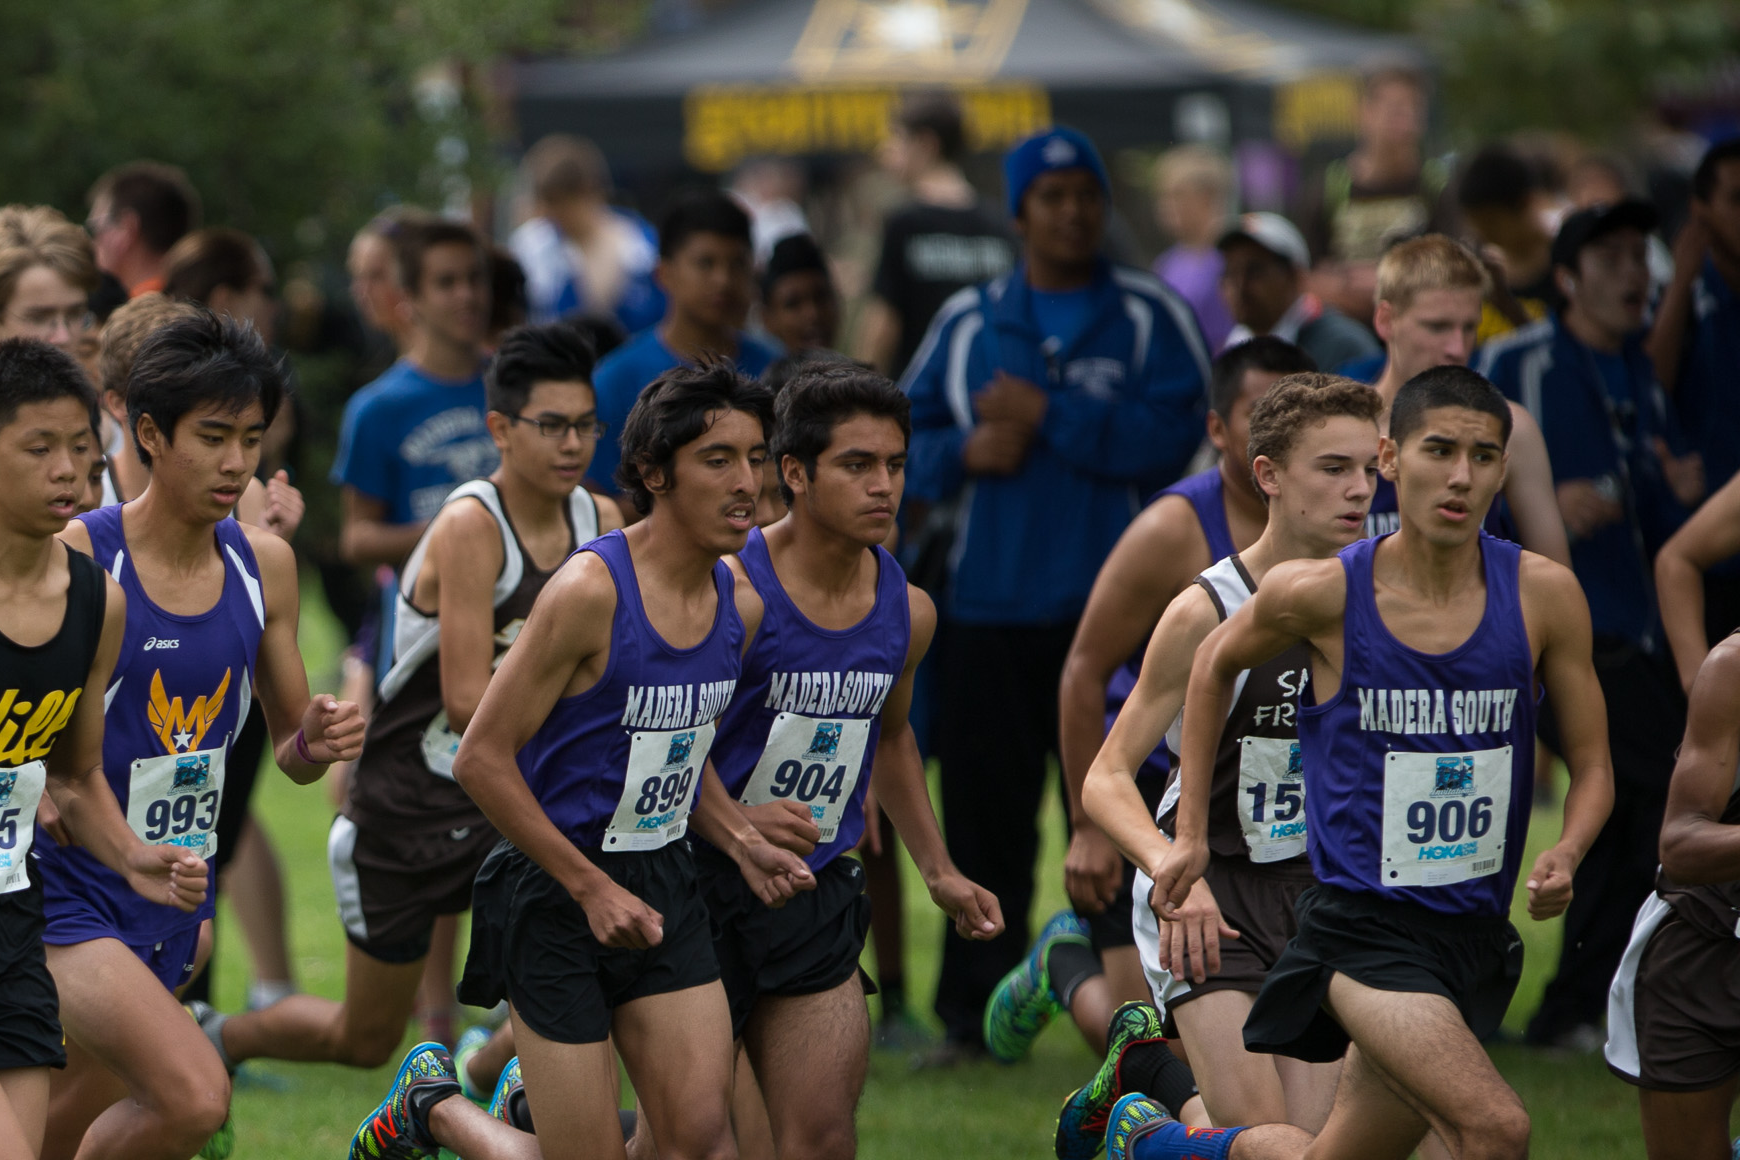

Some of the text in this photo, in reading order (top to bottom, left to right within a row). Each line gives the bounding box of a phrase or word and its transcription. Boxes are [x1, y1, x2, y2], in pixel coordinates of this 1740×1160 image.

[621, 679, 737, 729] MADERA SOUTH
[764, 671, 893, 715] MADERA SOUTH
[1358, 687, 1518, 735] MADERA SOUTH
[635, 766, 694, 815] 899
[769, 759, 847, 804] 904
[1246, 782, 1302, 823] 15
[145, 789, 219, 841] 993
[1407, 796, 1493, 844] 906
[1418, 844, 1463, 860] HOKA
